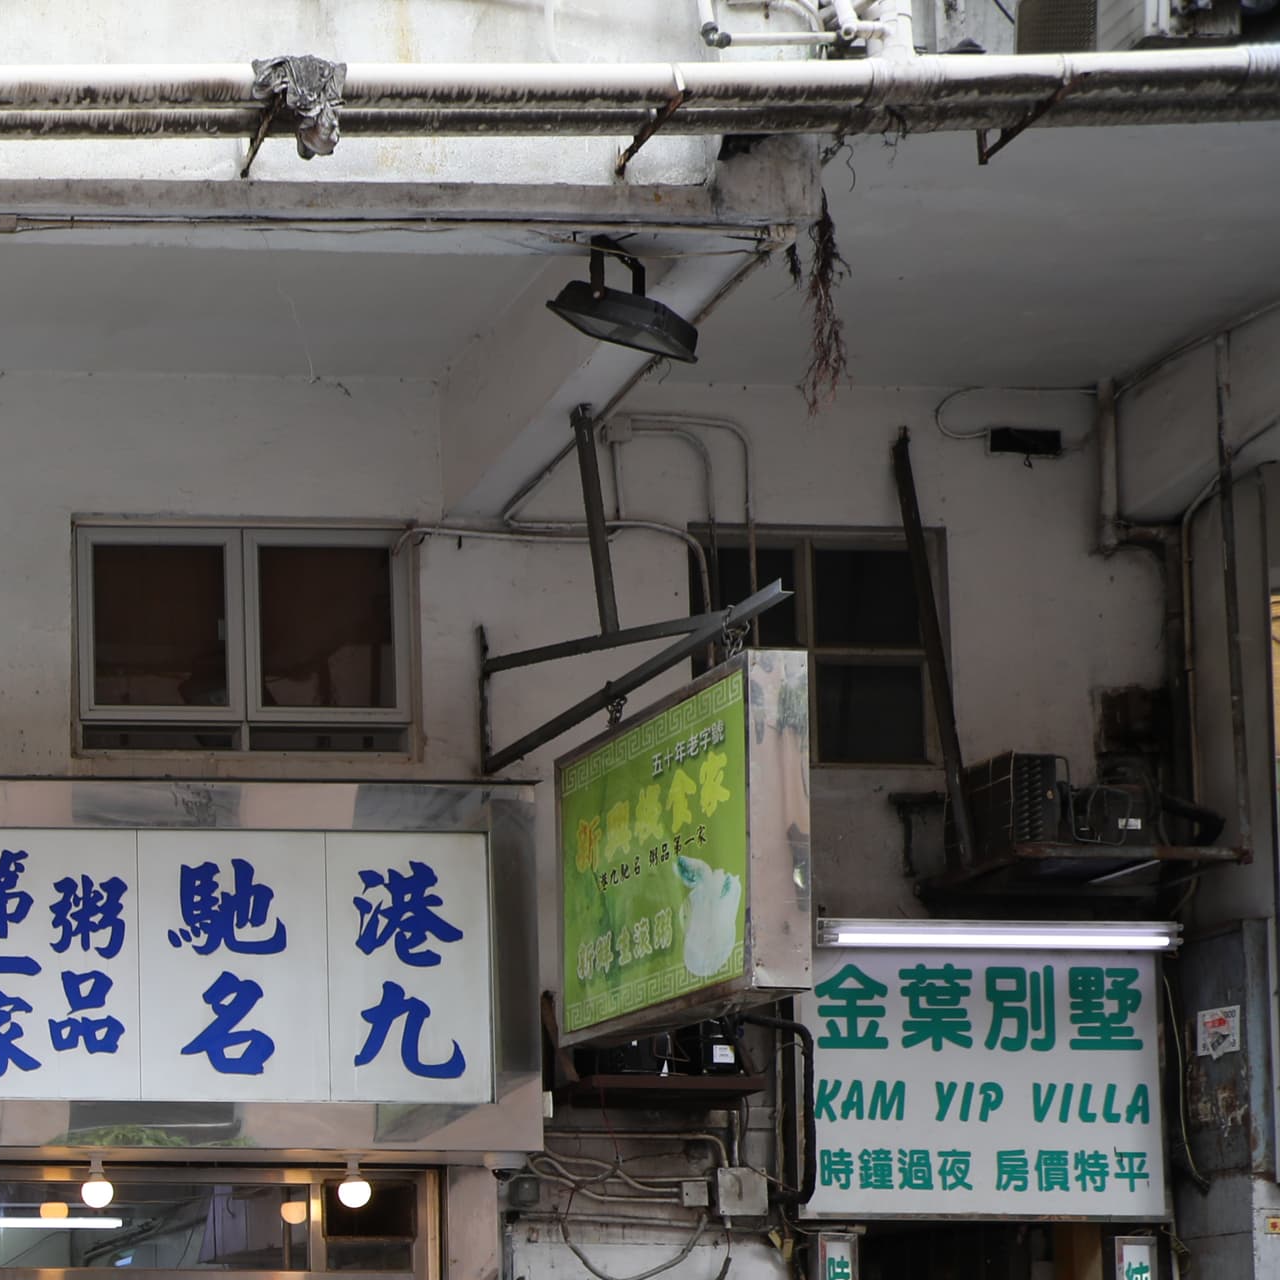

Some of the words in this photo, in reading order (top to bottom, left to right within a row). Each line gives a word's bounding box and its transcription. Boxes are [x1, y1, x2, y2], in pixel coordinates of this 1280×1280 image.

[651, 720, 726, 777] 五十年老字號
[48, 873, 128, 1055] 粥品
[167, 858, 287, 1077] 馳名
[352, 859, 466, 1079] 港九
[814, 963, 1144, 1052] 金葉別墅
[814, 1079, 906, 1122] KAM
[935, 1081, 1004, 1122] YIP
[1032, 1082, 1150, 1125] VILLA
[819, 1148, 974, 1191] 時鐘過夜
[995, 1149, 1150, 1193] 房價特平
